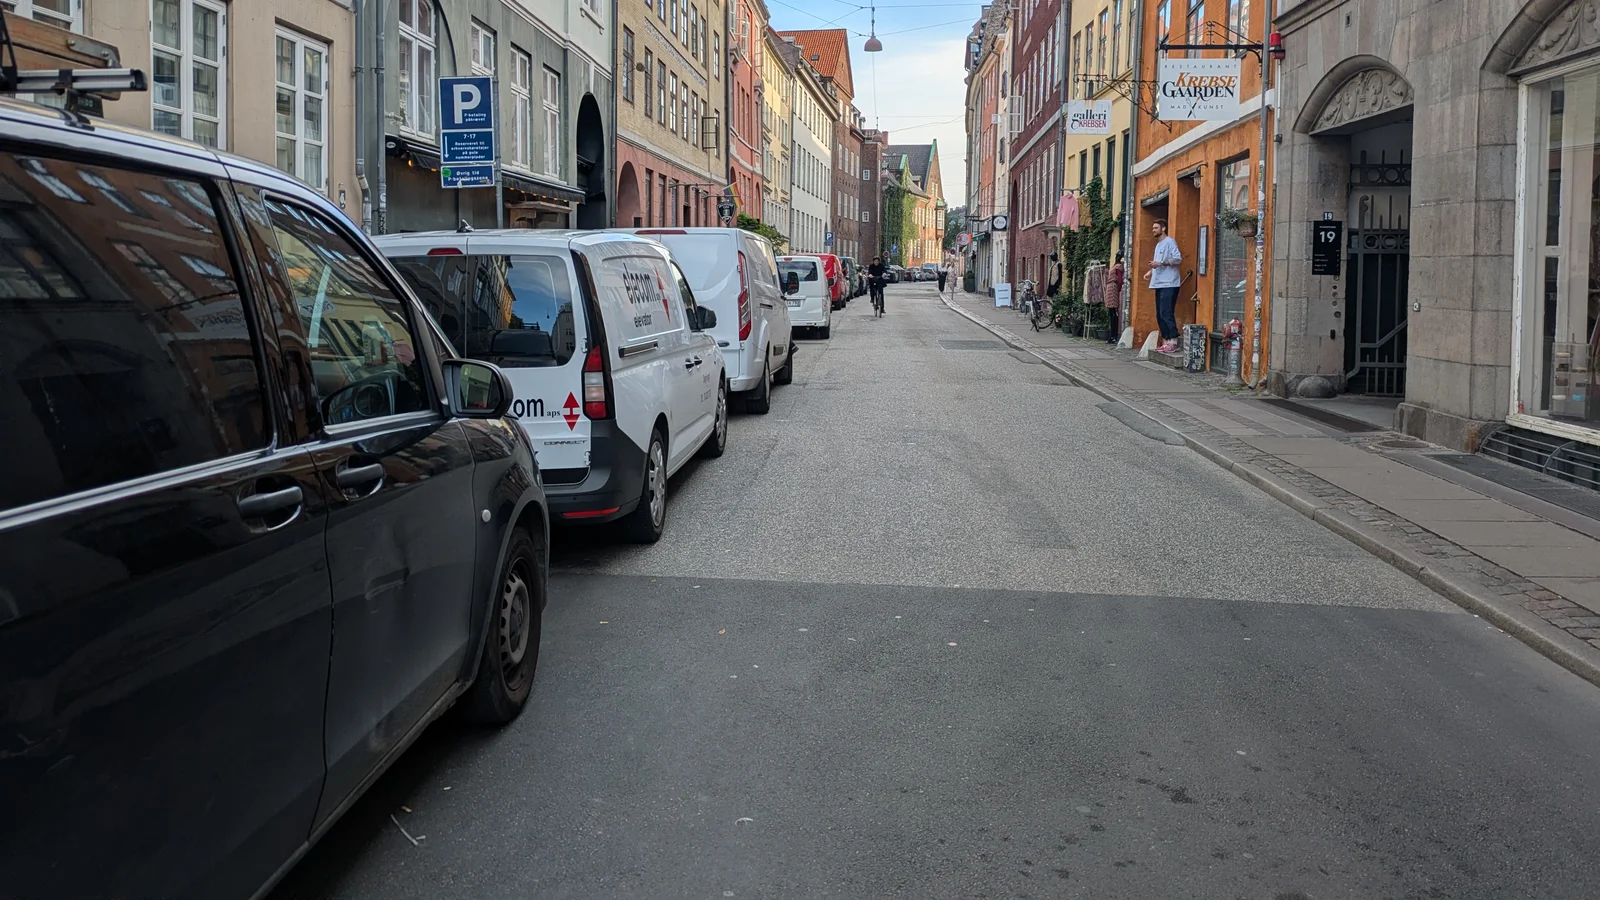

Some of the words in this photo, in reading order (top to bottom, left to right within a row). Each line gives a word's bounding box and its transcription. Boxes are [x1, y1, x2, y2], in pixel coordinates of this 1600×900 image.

[1176, 72, 1238, 88] KREBSE
[1162, 81, 1235, 101] GAARDEN
[453, 84, 481, 124] P
[1071, 109, 1107, 130] galleri
[1078, 119, 1107, 128] KREBSEN
[1324, 212, 1333, 220] 19
[1319, 231, 1336, 243] 19
[546, 410, 561, 418] aps
